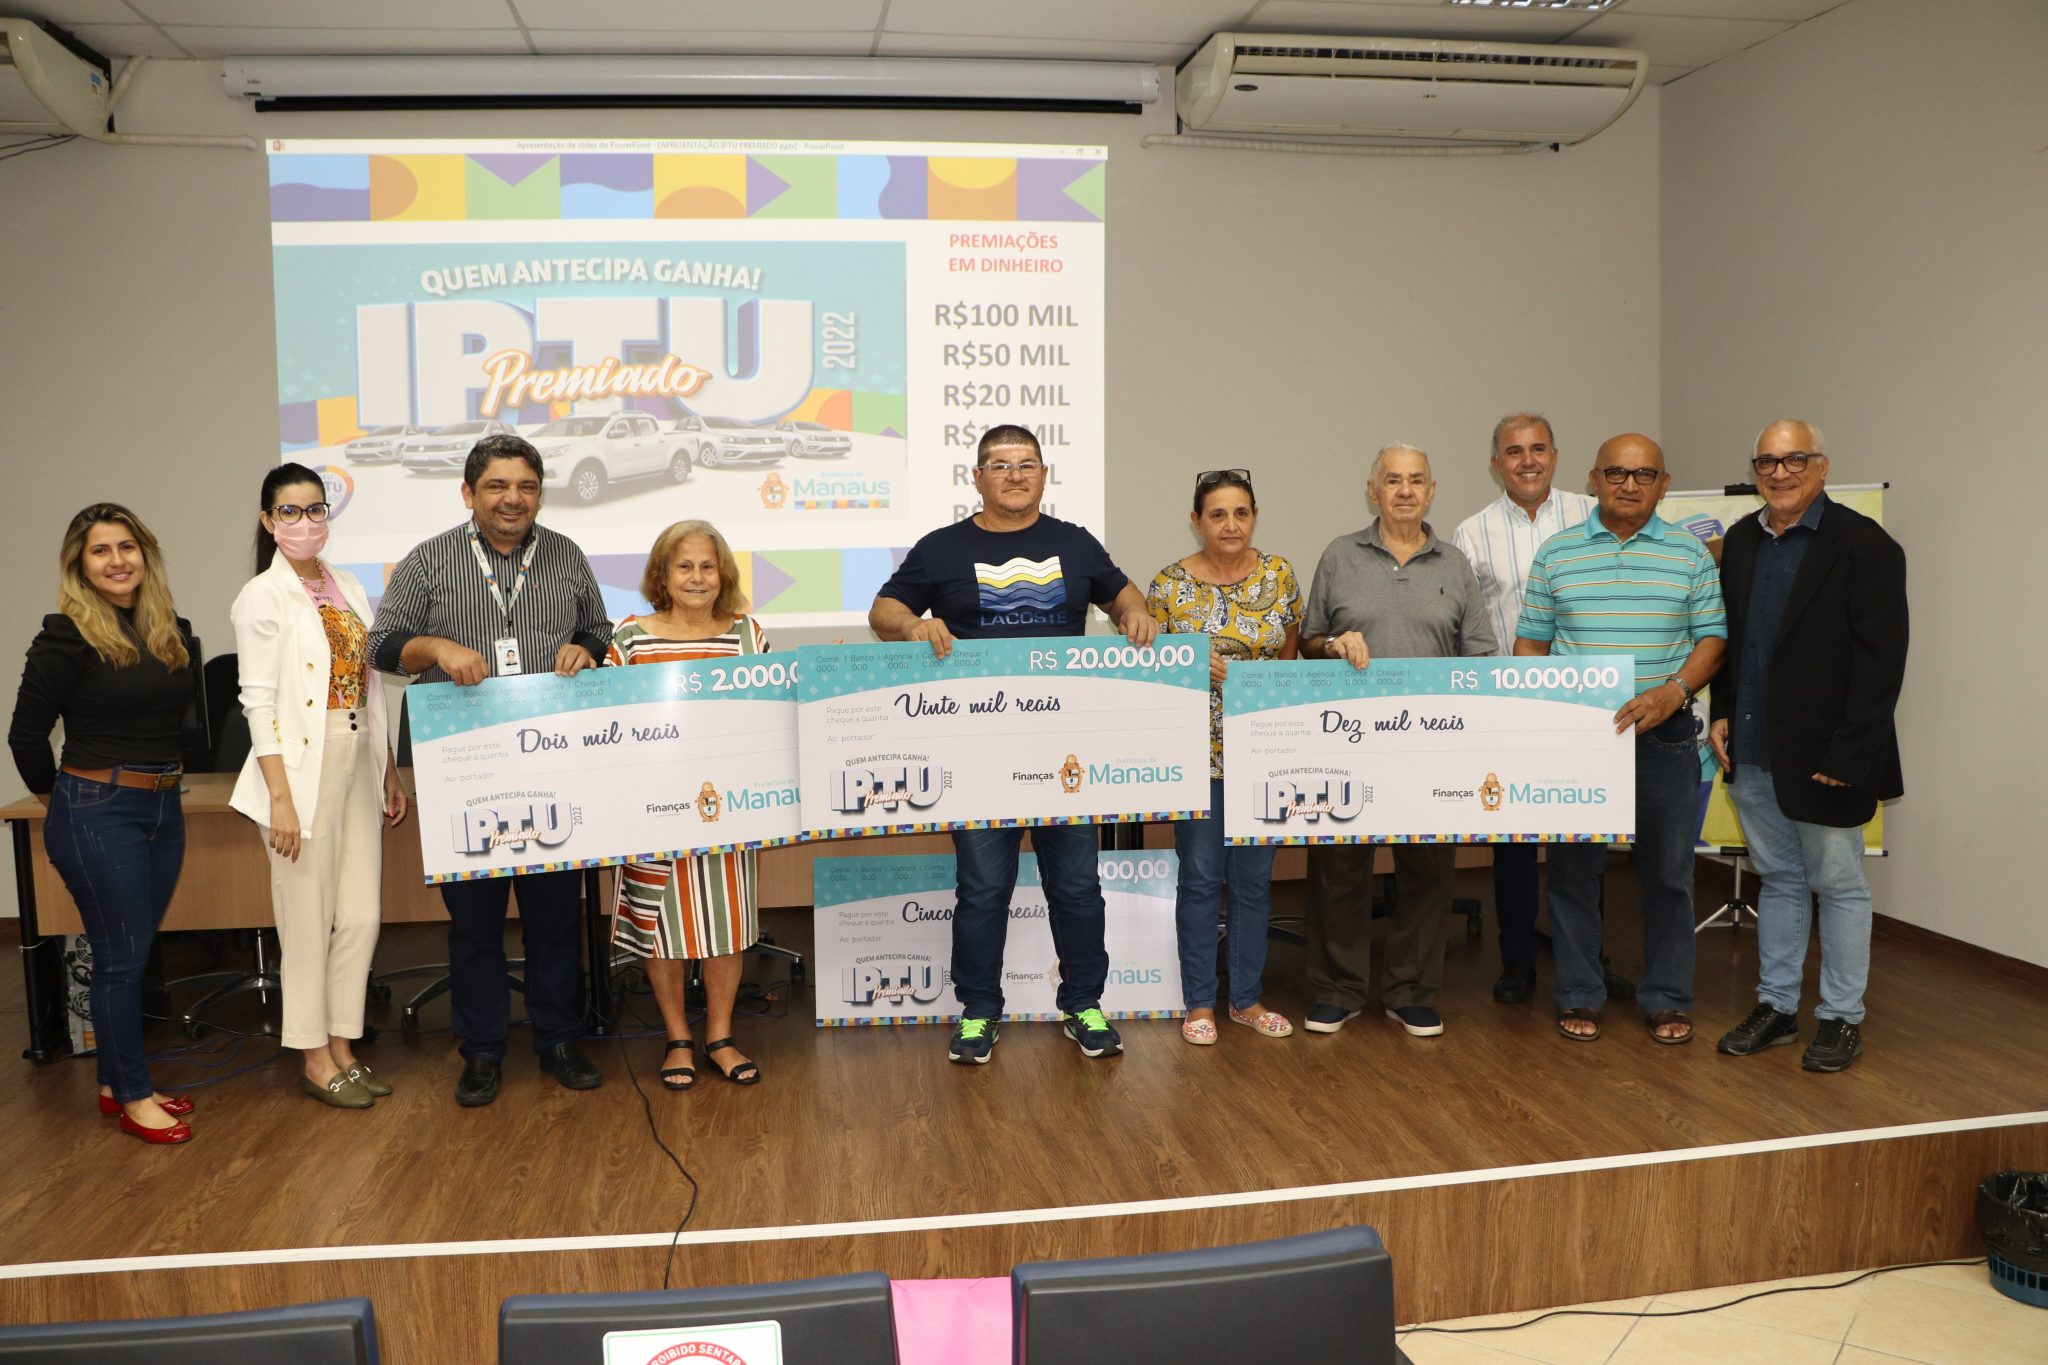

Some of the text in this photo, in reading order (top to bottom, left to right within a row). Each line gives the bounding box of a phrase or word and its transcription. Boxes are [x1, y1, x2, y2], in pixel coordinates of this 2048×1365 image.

[567, 141, 576, 149] de
[578, 141, 597, 149] slides
[599, 141, 608, 149] do
[610, 141, 651, 149] PowerPoint
[949, 231, 1059, 252] PREMIAÇÕES
[949, 258, 1064, 273] EM DINHEIRO
[421, 258, 763, 296] QUEM ANTECIPA GANHA!
[934, 300, 1079, 330] R$100 MIL
[822, 311, 856, 370] 2022
[355, 296, 815, 428] IPTU
[943, 340, 1071, 369] R$50 MIL
[480, 348, 714, 417] Premiado
[943, 381, 1071, 410] R$20 MIL
[793, 478, 891, 497] Manaus
[980, 611, 1068, 627] LACOSTE
[850, 654, 875, 662] Banco
[1030, 644, 1195, 672] R$ 20.000,00
[1274, 671, 1298, 679] Banco
[1376, 669, 1405, 678] Cheque
[1450, 666, 1619, 694] R$ 10.000,00
[574, 679, 605, 690] Cheque
[671, 671, 703, 697] R$
[826, 706, 850, 716] Pague
[851, 706, 864, 715] por
[894, 690, 1061, 718] Vinte mil reais
[826, 716, 854, 725] cheque
[1250, 720, 1273, 729] Pague
[1319, 709, 1465, 744] Dez mil reais
[516, 720, 680, 754] Dois mil reais
[827, 733, 874, 743] Ao portador
[1250, 729, 1277, 737] cheque
[441, 742, 501, 756] Pague por este
[1251, 746, 1297, 756] Ao portador
[442, 755, 472, 765] cheque
[845, 753, 930, 767] QUEM ANTECIPA GANHA!
[444, 772, 495, 783] Ao portador
[943, 770, 953, 789] 2022
[1012, 771, 1055, 782] Finanças
[1088, 763, 1184, 786] Manaus
[1268, 767, 1352, 778] QUEM ANTECIPA GANHA!
[830, 765, 943, 812] IPTU
[1364, 785, 1374, 803] 2022
[1432, 788, 1474, 799] Finanças
[1508, 782, 1607, 805] Manaus
[466, 790, 557, 807] QUEM ANTECIPA GANHA!
[646, 800, 691, 814] Finanças
[726, 787, 801, 813] Mana
[864, 788, 912, 808] Premiado
[1253, 780, 1364, 821] IPTU
[573, 805, 583, 826] 2022
[450, 802, 574, 854] IPTU
[838, 911, 859, 919] Pague
[902, 901, 955, 923] Cinco
[852, 935, 882, 944] portador
[855, 953, 932, 964] QUEM ANTECIPA GANHA!
[842, 965, 944, 1003] IPTU
[1005, 971, 1045, 982] Finanças
[1105, 967, 1162, 985] naus
[650, 1343, 697, 1365] ROIBIDO
